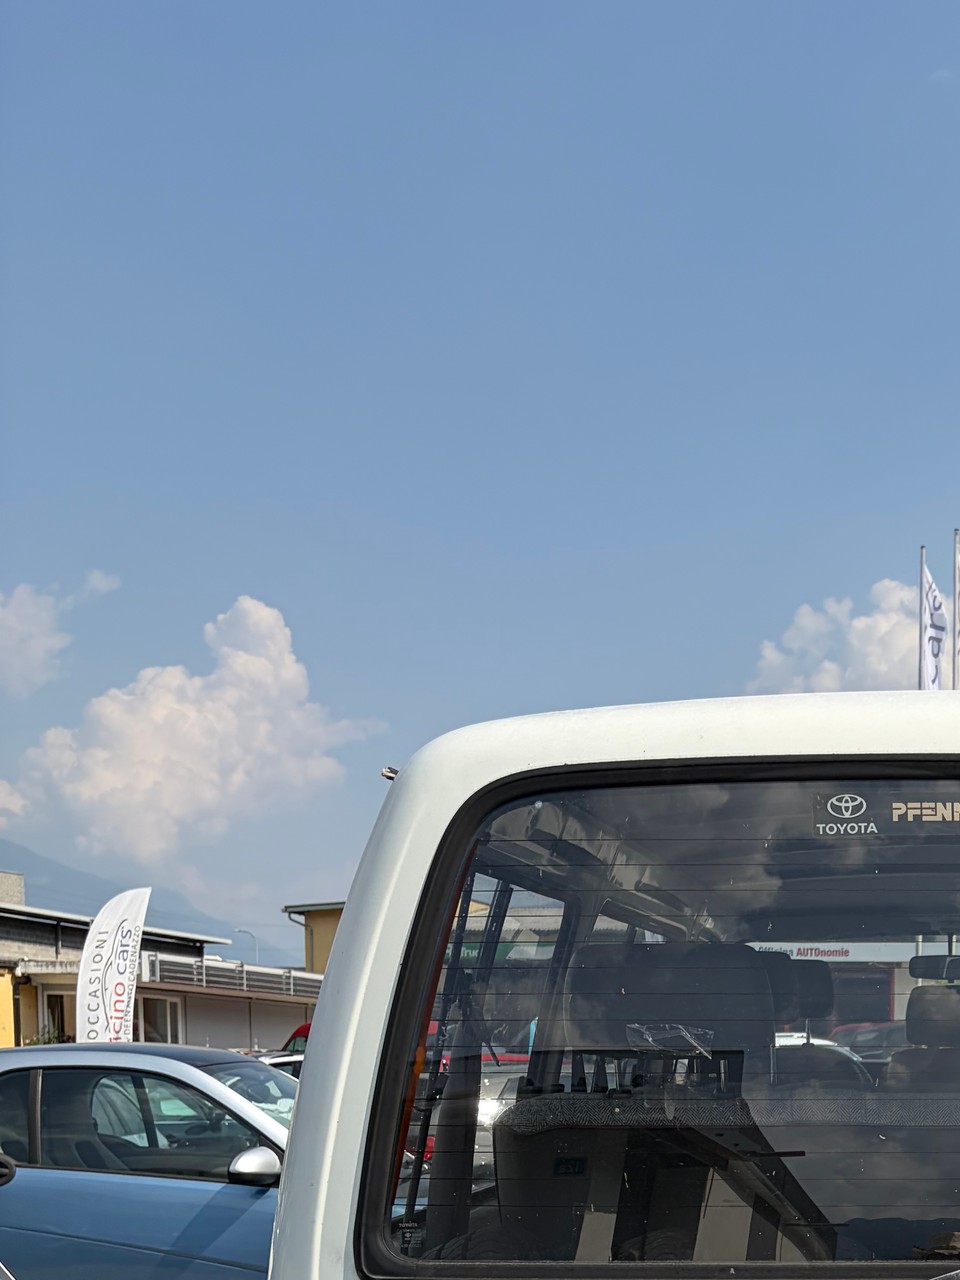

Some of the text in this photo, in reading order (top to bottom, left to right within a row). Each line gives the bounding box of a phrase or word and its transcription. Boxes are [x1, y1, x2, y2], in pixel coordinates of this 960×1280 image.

[816, 821, 879, 835] TOYOTA
[116, 929, 133, 976] cars
[128, 925, 141, 982] CADENAZZO
[796, 947, 850, 958] AUTOnomie
[86, 930, 109, 1041] OCCASIONI
